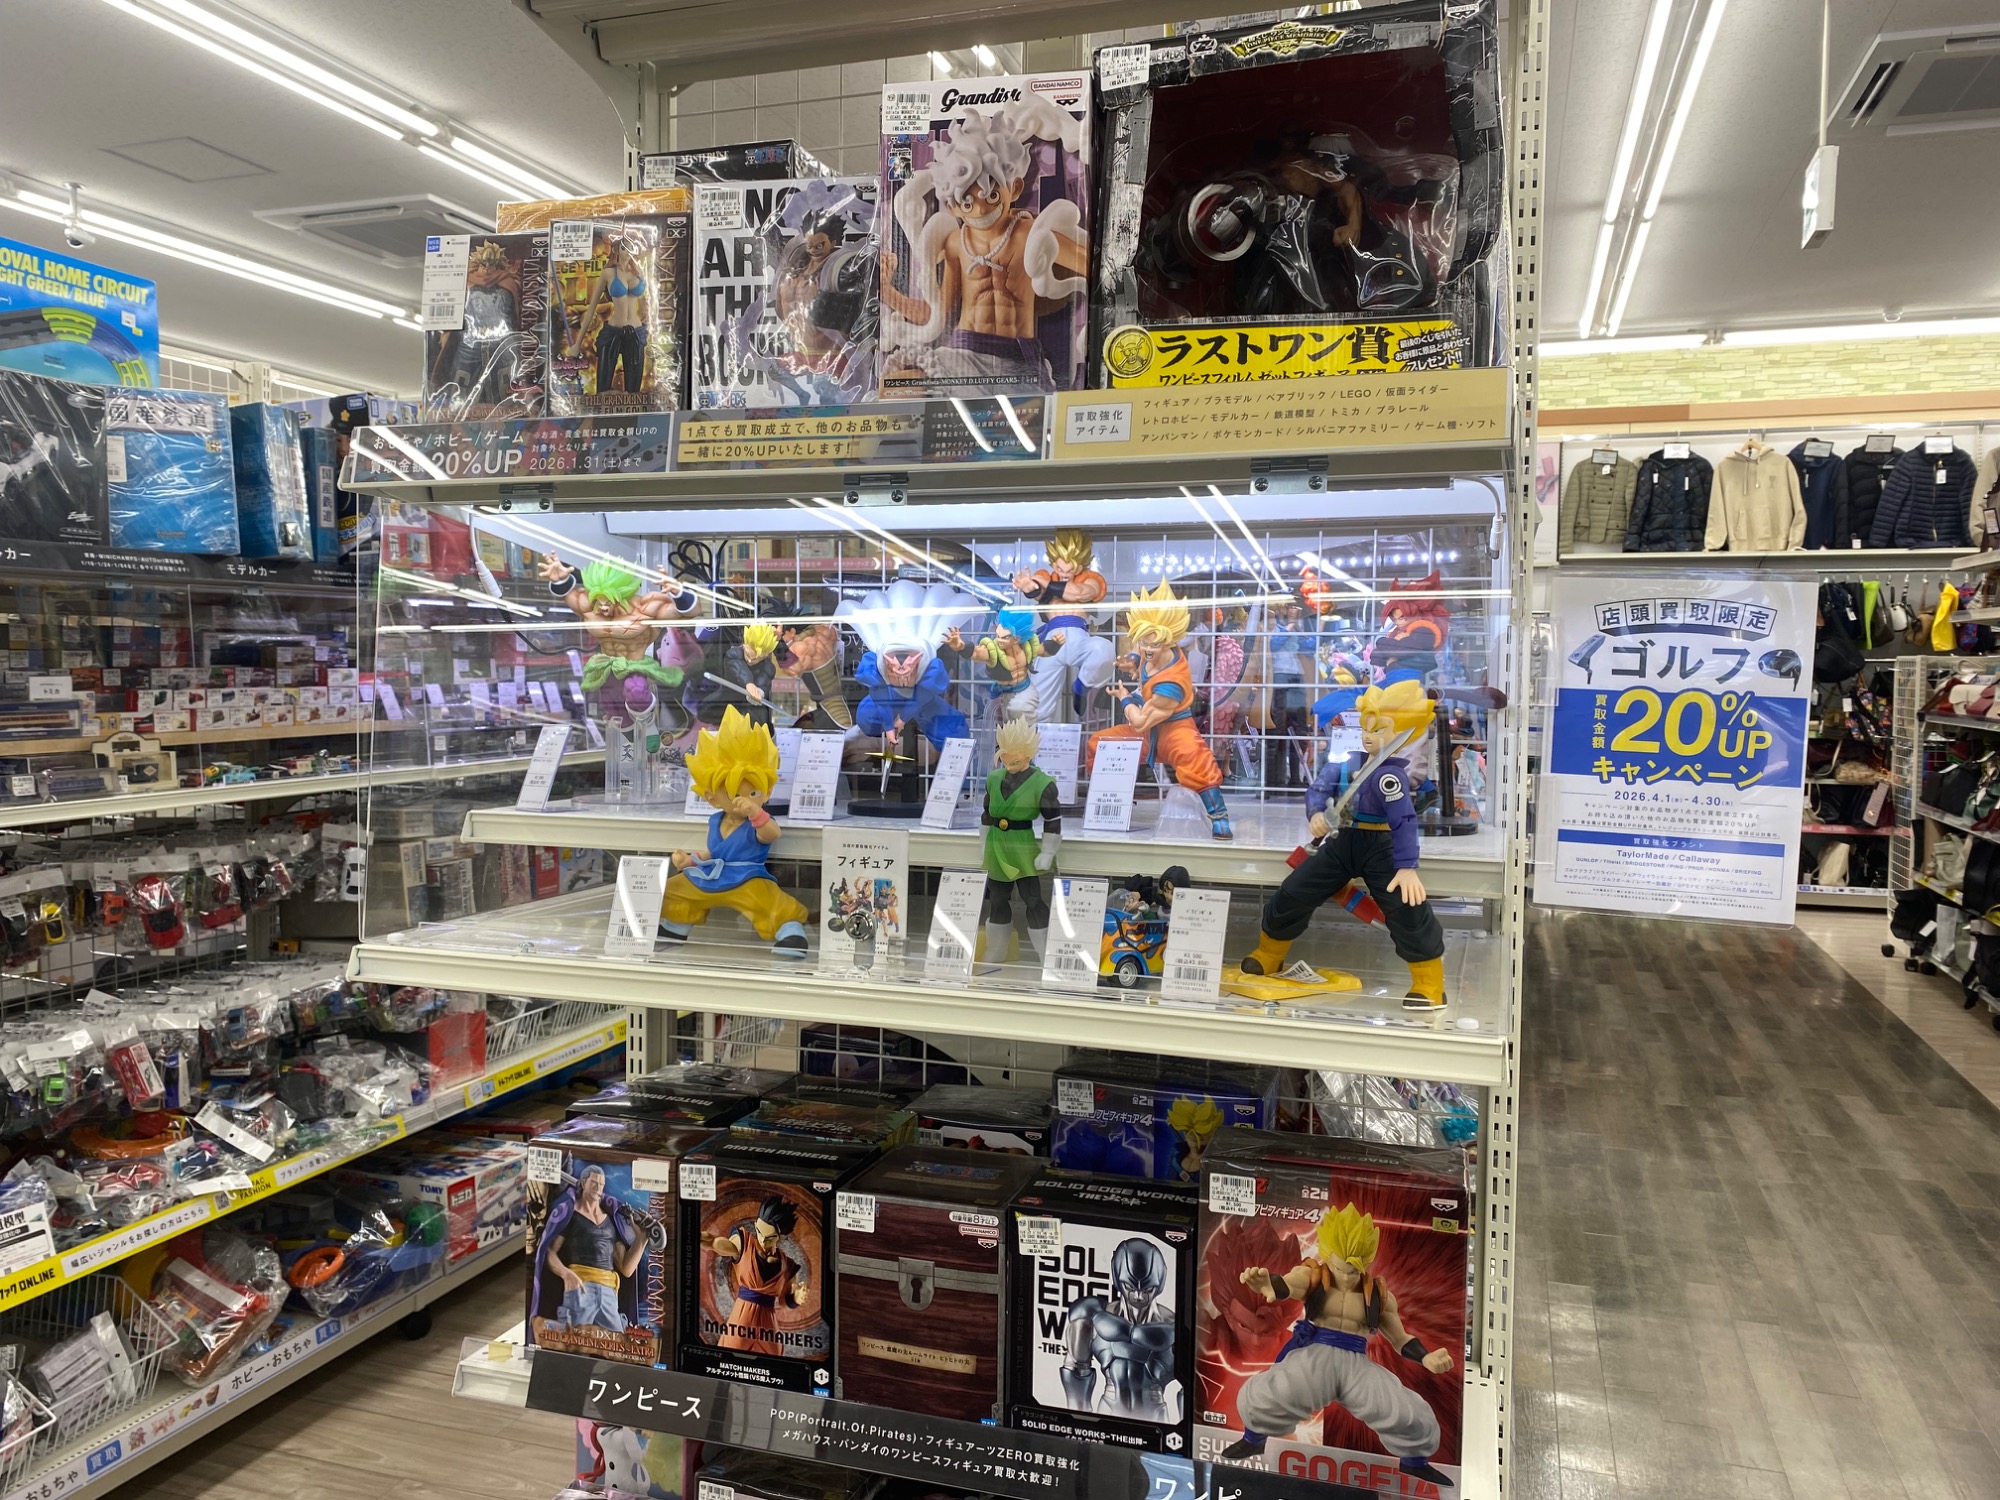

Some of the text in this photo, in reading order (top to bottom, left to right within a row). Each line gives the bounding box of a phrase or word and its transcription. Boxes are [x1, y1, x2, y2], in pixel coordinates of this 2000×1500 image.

[1033, 80, 1081, 89] BANDAI NAMCO
[0, 246, 149, 305] OVAL HOME CIRCUIT
[1156, 325, 1398, 369] ラストワン賞
[1395, 337, 1471, 361] お客様に景品とあわせて
[1400, 328, 1462, 348] 最後のくじを引いた
[1407, 351, 1463, 371] プレゼント!!
[1143, 396, 1191, 409] フィギュア
[1203, 393, 1254, 407] プラモデル
[1340, 388, 1372, 400] LEGO
[1385, 384, 1450, 398] 仮面ライダー
[108, 403, 209, 429] 国産鉄道
[1073, 410, 1124, 424] 買取強化
[1142, 403, 1430, 426] レトロホビー モデルカー 鉄道模型 トミカ プラレール
[687, 418, 903, 438] 1点でも買取成立で、他のお品物も
[1076, 424, 1120, 438] アイテム
[1141, 417, 1497, 443] アンパンマン ポケモンカード シルバニアファミリー ゲーム機・ソフト
[683, 441, 851, 460] 一緒に20%UPいたします!
[369, 450, 523, 476] 買取金額 20%UP
[529, 455, 642, 471] 2026.1.31(土)まで
[321, 466, 334, 523] 国産鉄道
[226, 563, 279, 577] モデルカー
[1601, 600, 1771, 632] 店頭買取限定
[1610, 638, 1751, 685] ゴルフ
[1591, 694, 1608, 750] 買取金額
[1610, 688, 1773, 759] 20% UP
[1591, 756, 1764, 789] キャンペーン
[1633, 837, 1704, 849] 買取強化ブランド
[837, 855, 895, 870] フィギュア
[1617, 849, 1721, 866] TaylorMade Callaway
[1625, 861, 1665, 869] BRIDGESTONE
[723, 1143, 839, 1162] MATCH MAKERS
[239, 1182, 273, 1201] FASHION
[419, 1184, 444, 1195] TOMY
[451, 1187, 473, 1208] トミカ
[1033, 1179, 1081, 1191] SOLID
[1083, 1183, 1133, 1196] EDGE
[1137, 1188, 1198, 1205] WORKS
[70, 1206, 206, 1270] 幅広いジャンルをお探しの方はこちら
[18, 1267, 56, 1292] ONLINE
[560, 1333, 599, 1350] GRANDLINE
[599, 1339, 626, 1353] SERIES
[595, 1329, 621, 1341] DXF
[704, 1319, 824, 1350] MATCH MAKERS
[231, 1321, 341, 1390] ホビー・おもちゃ 買取
[861, 1341, 885, 1351] ワンピース
[719, 1361, 770, 1377] MATCH MAKERS
[587, 1378, 703, 1421] ワンピース
[1022, 1419, 1047, 1431] SOLID
[1049, 1423, 1073, 1435] EDGE
[89, 1446, 120, 1471] 買取
[782, 1428, 1061, 1488] メガハウス・バンダイのワンピースフィギュア買取大歓迎!
